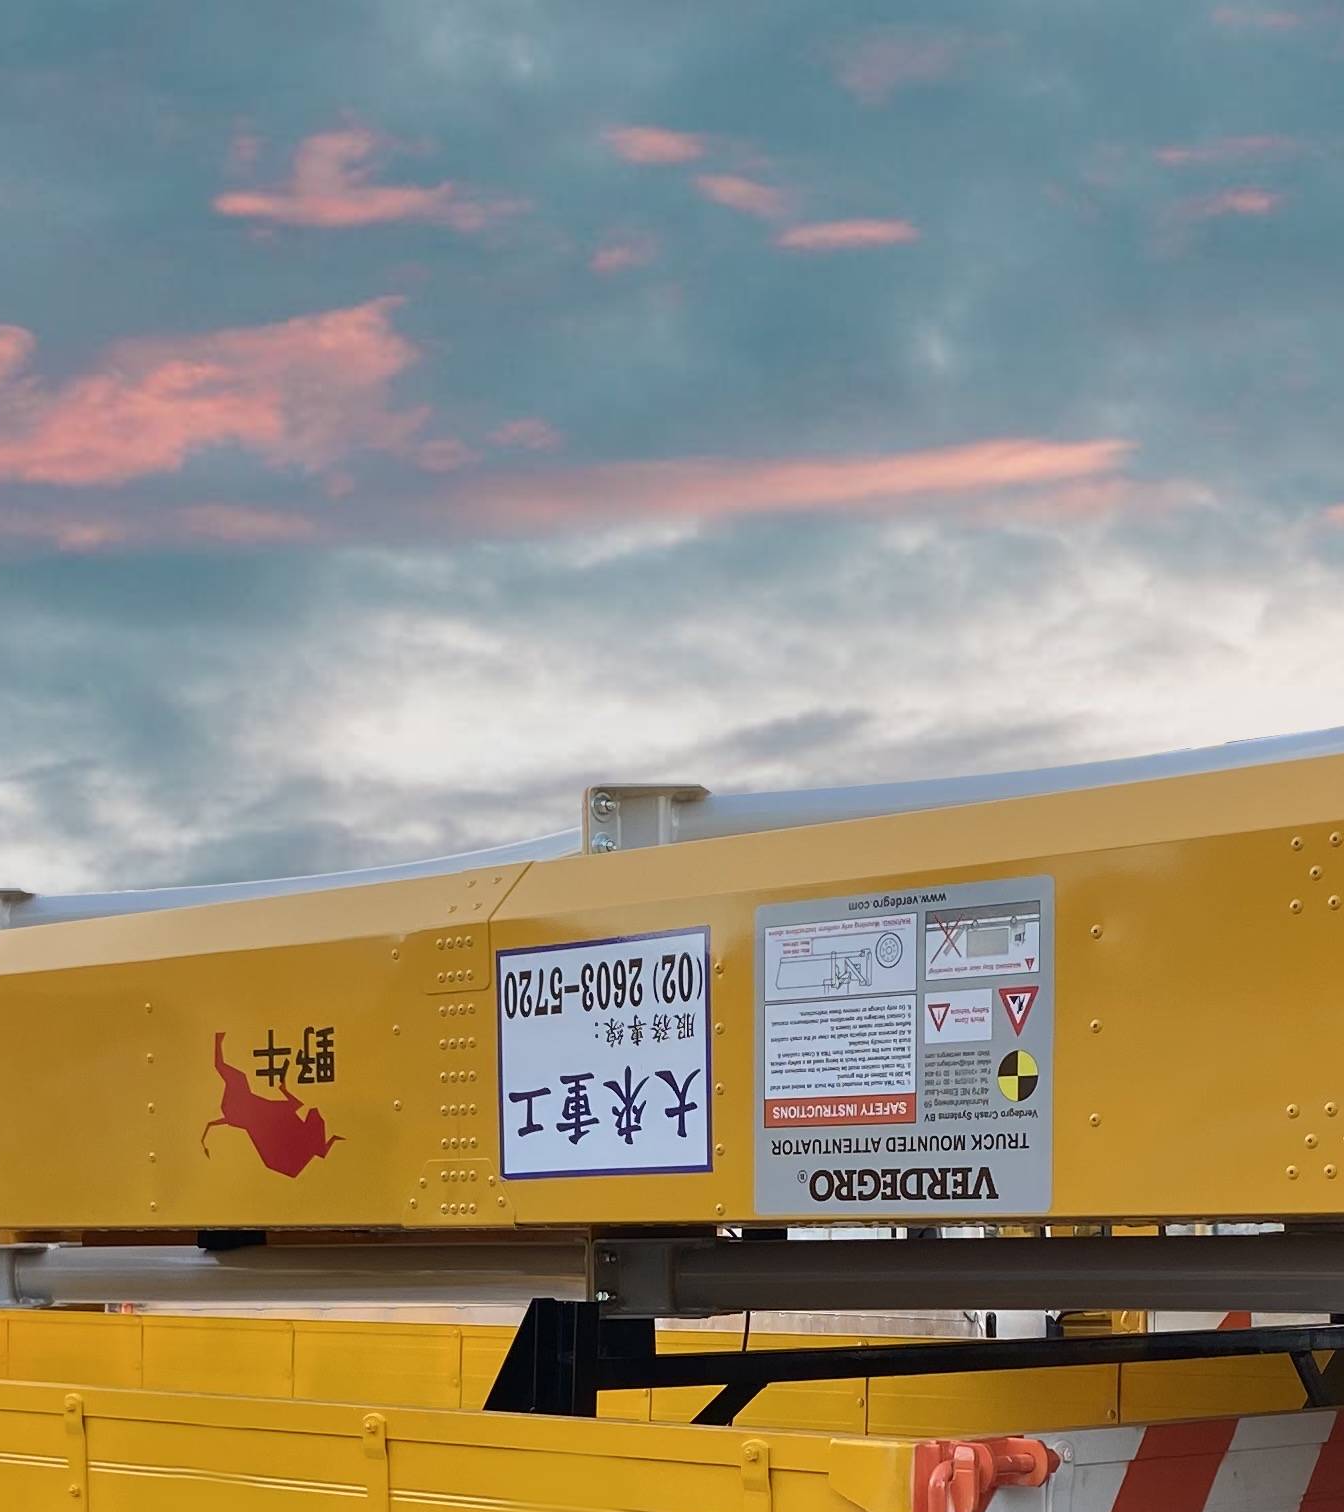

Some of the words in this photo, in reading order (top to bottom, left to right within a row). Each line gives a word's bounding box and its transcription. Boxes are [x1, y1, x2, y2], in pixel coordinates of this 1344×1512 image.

[848, 892, 947, 912] www.verdegro.com
[653, 952, 703, 1004] (02)
[504, 958, 643, 1019] 2603-5720
[253, 1026, 335, 1087] 野牛
[509, 1066, 701, 1145] 大來重工
[772, 1104, 858, 1119] INSTRUCTIONS
[860, 1101, 907, 1115] SAFETY
[1000, 1108, 1038, 1119] Verdegro
[924, 1113, 936, 1122] BV
[938, 1111, 972, 1121] Systems
[974, 1111, 999, 1120] Crash
[771, 1137, 882, 1156] ATTENTUATOR
[885, 1135, 966, 1154] MOUNTED
[970, 1132, 1030, 1151] TRUCK
[809, 1166, 999, 1202] VERDEGRO
